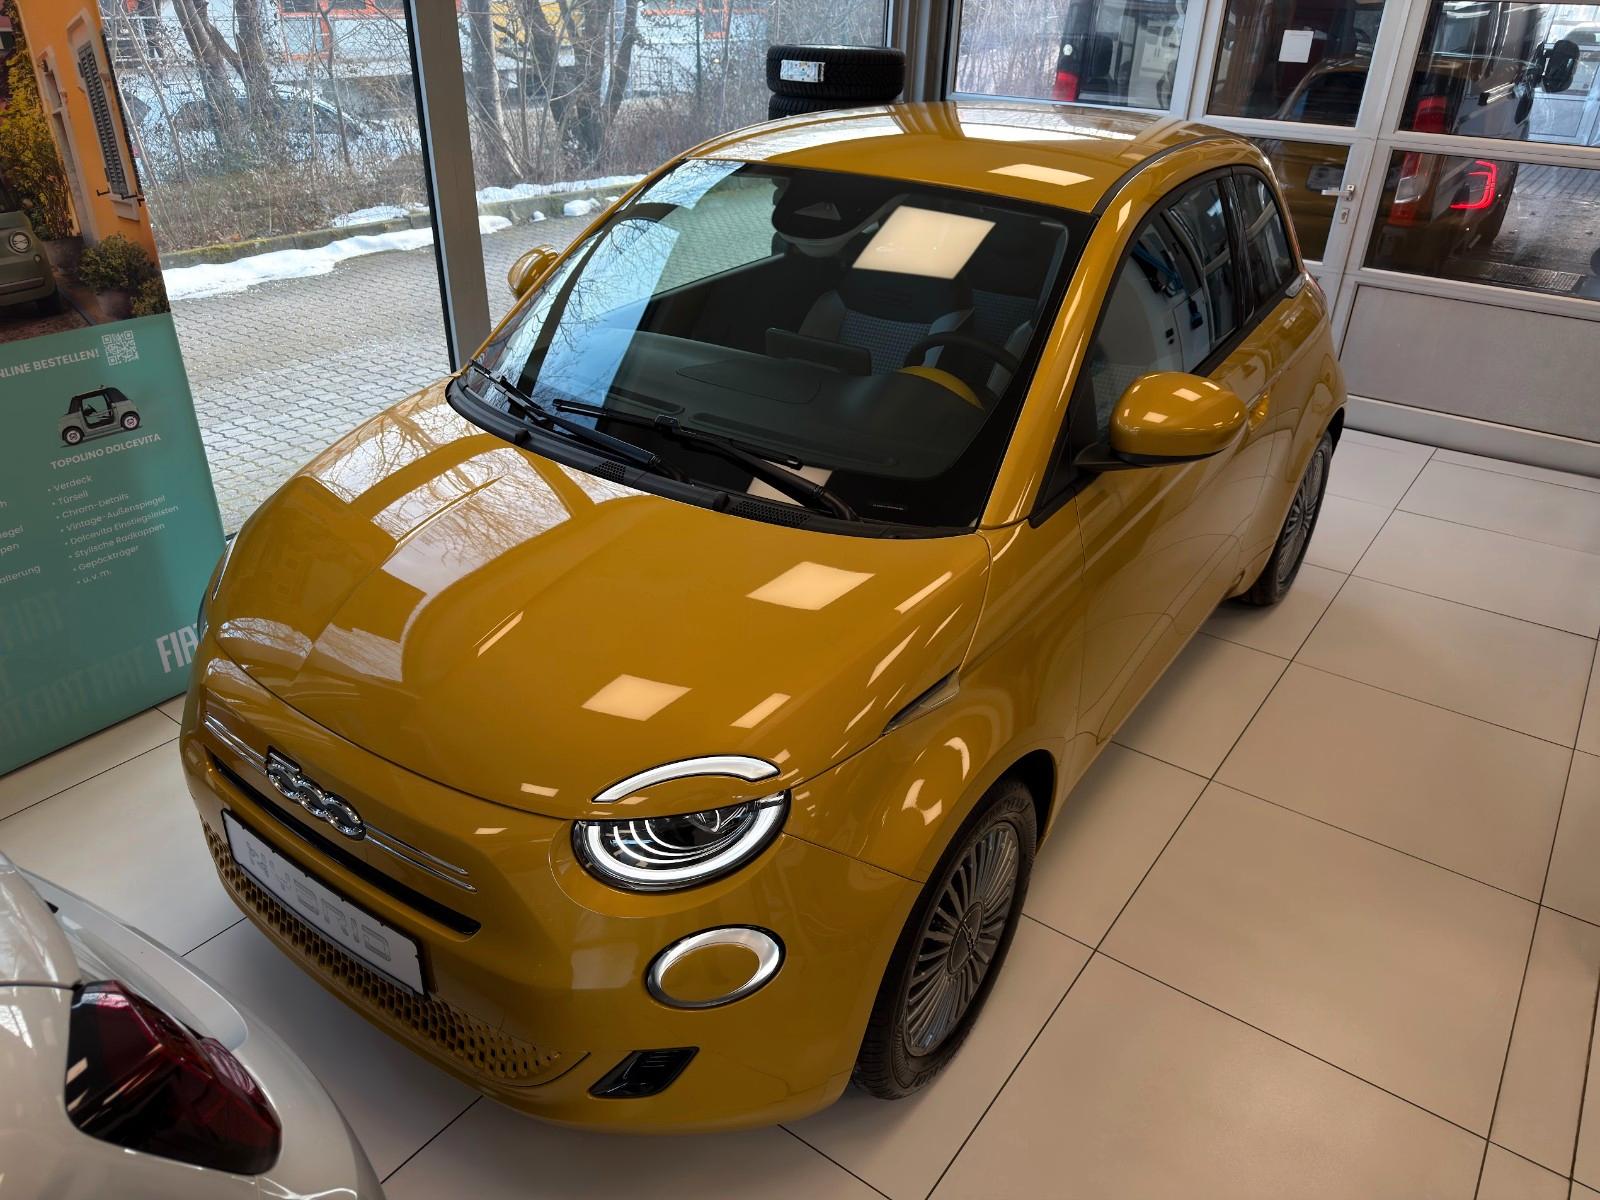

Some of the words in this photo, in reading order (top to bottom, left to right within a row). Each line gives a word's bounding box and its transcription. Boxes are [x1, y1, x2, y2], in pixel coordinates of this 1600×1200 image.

[32, 348, 99, 371] BESTELLEN!
[51, 448, 104, 470] TOPOLINO
[105, 433, 161, 455] DOLCEVITA
[54, 475, 93, 491] Verdeck
[156, 622, 198, 674] FIA
